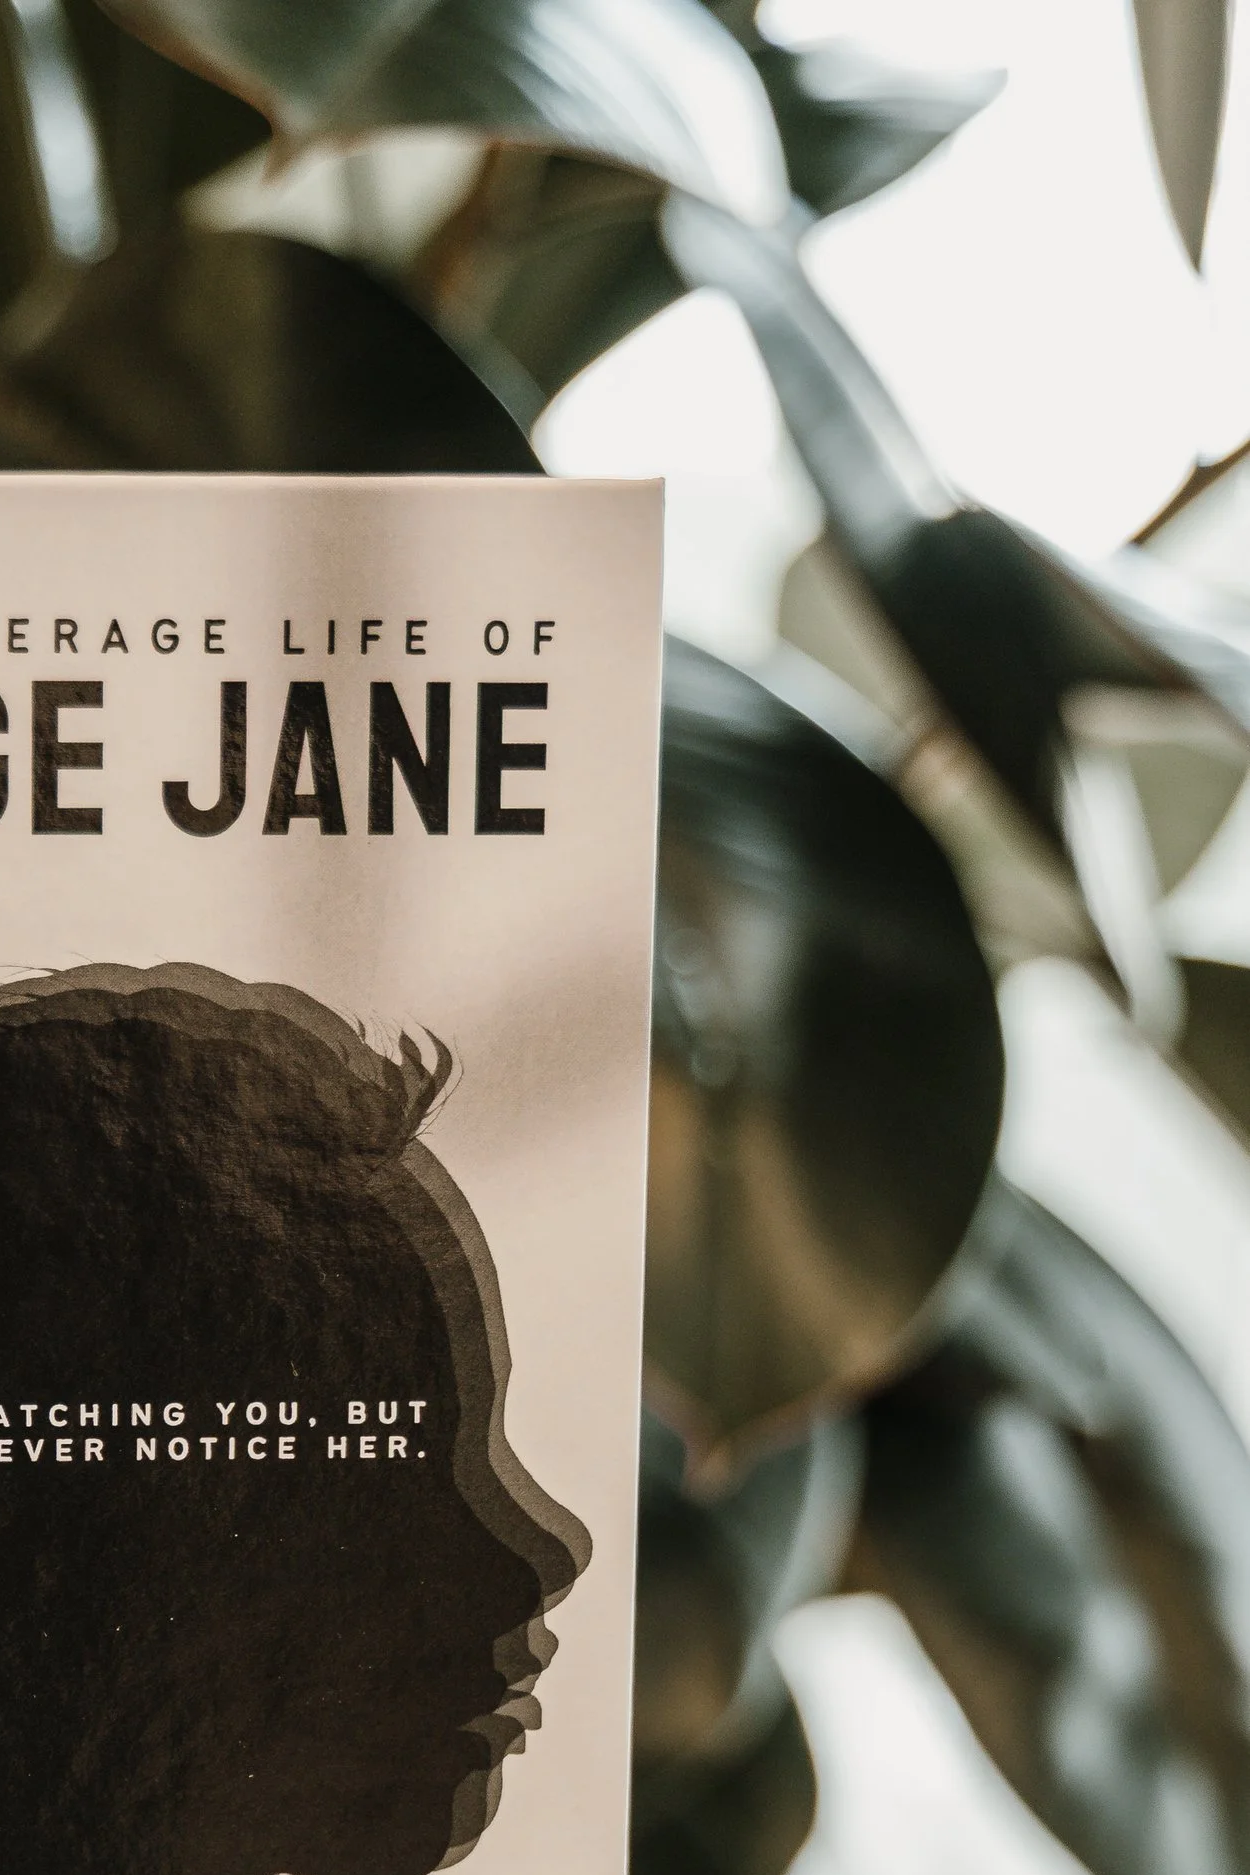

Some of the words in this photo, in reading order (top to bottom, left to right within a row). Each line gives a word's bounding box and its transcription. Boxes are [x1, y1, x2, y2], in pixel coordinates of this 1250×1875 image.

[282, 618, 429, 656] LIFE
[483, 619, 556, 656] OF
[161, 679, 549, 838] JANE
[216, 1401, 317, 1428] YOU,
[347, 1400, 427, 1425] BUT
[136, 1436, 296, 1461] NOTICE
[327, 1435, 426, 1459] HER.
